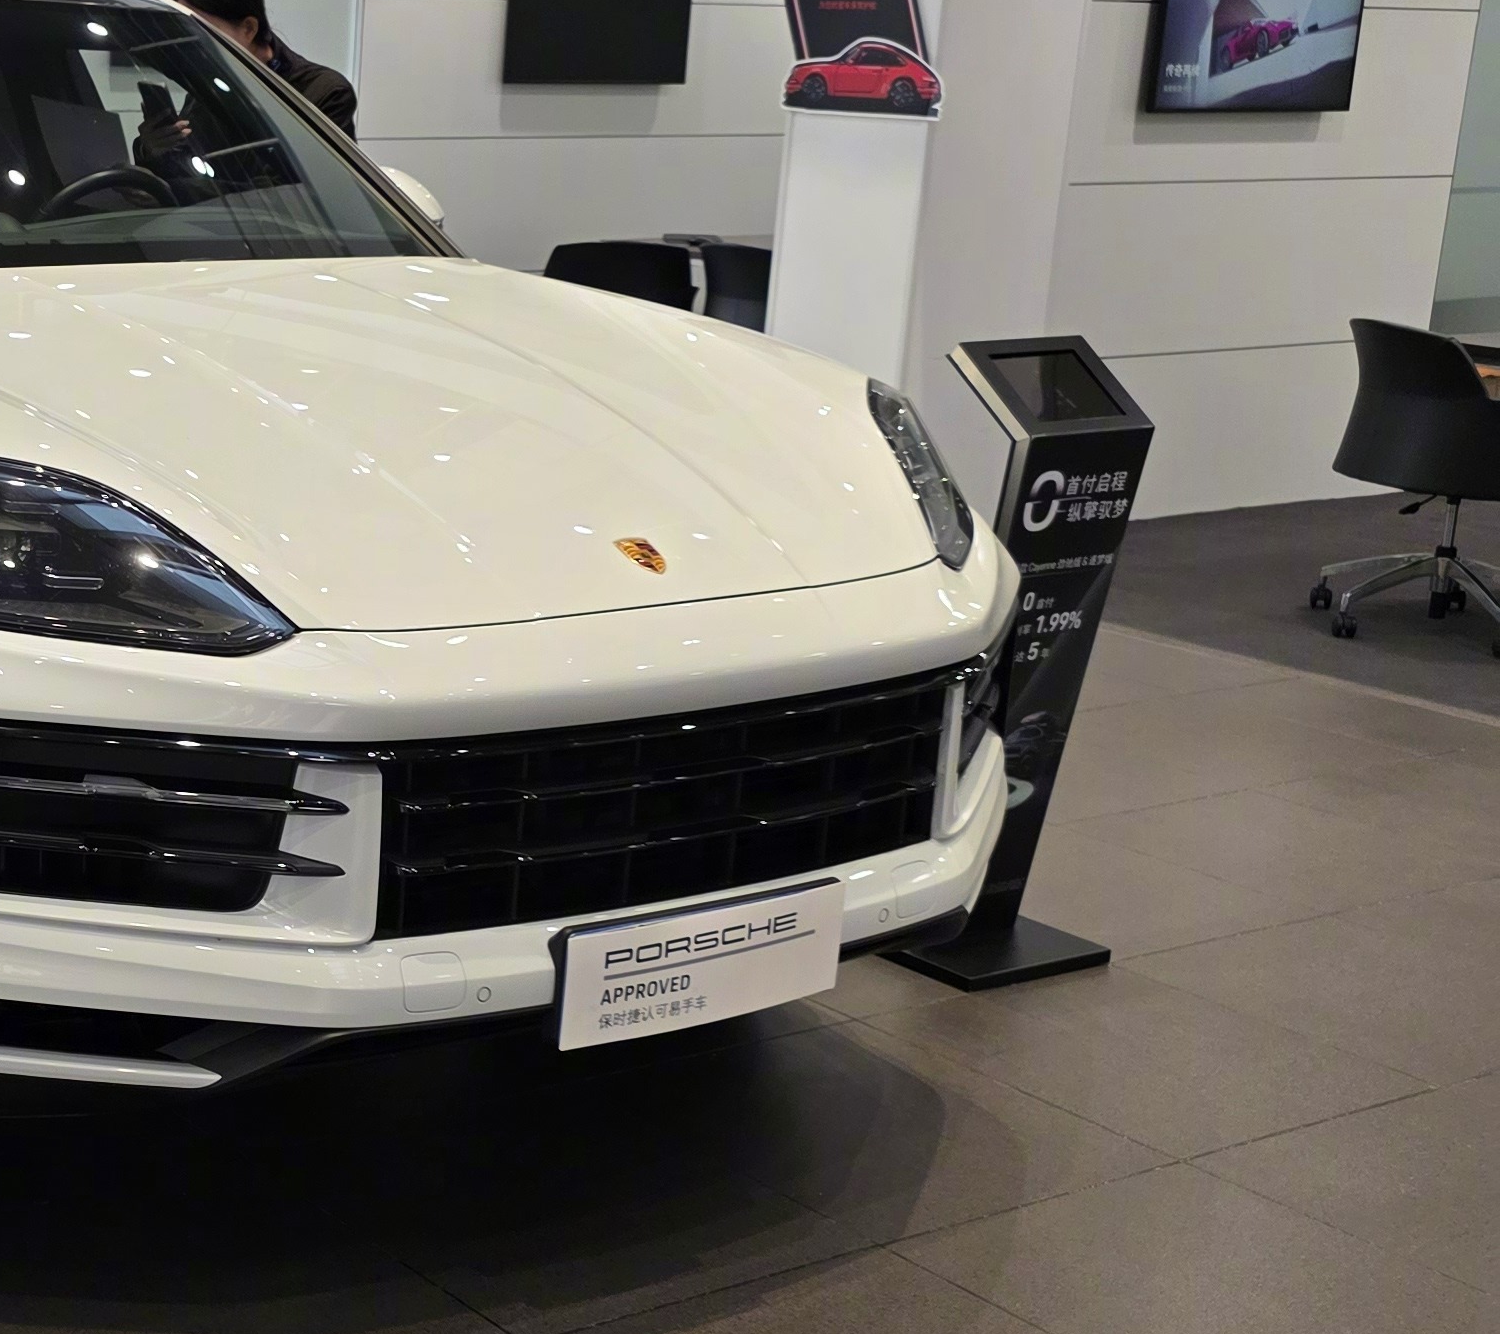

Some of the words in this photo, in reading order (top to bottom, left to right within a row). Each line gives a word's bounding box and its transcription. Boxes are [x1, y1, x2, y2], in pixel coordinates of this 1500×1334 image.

[1066, 471, 1129, 496] 首付启程
[1023, 591, 1036, 612] 0
[1036, 610, 1083, 634] 1.99%
[1027, 641, 1041, 661] 5
[604, 912, 798, 969] PORSCHE
[600, 974, 691, 1006] APPROVED
[598, 995, 708, 1030] 保时捷认可易手车
